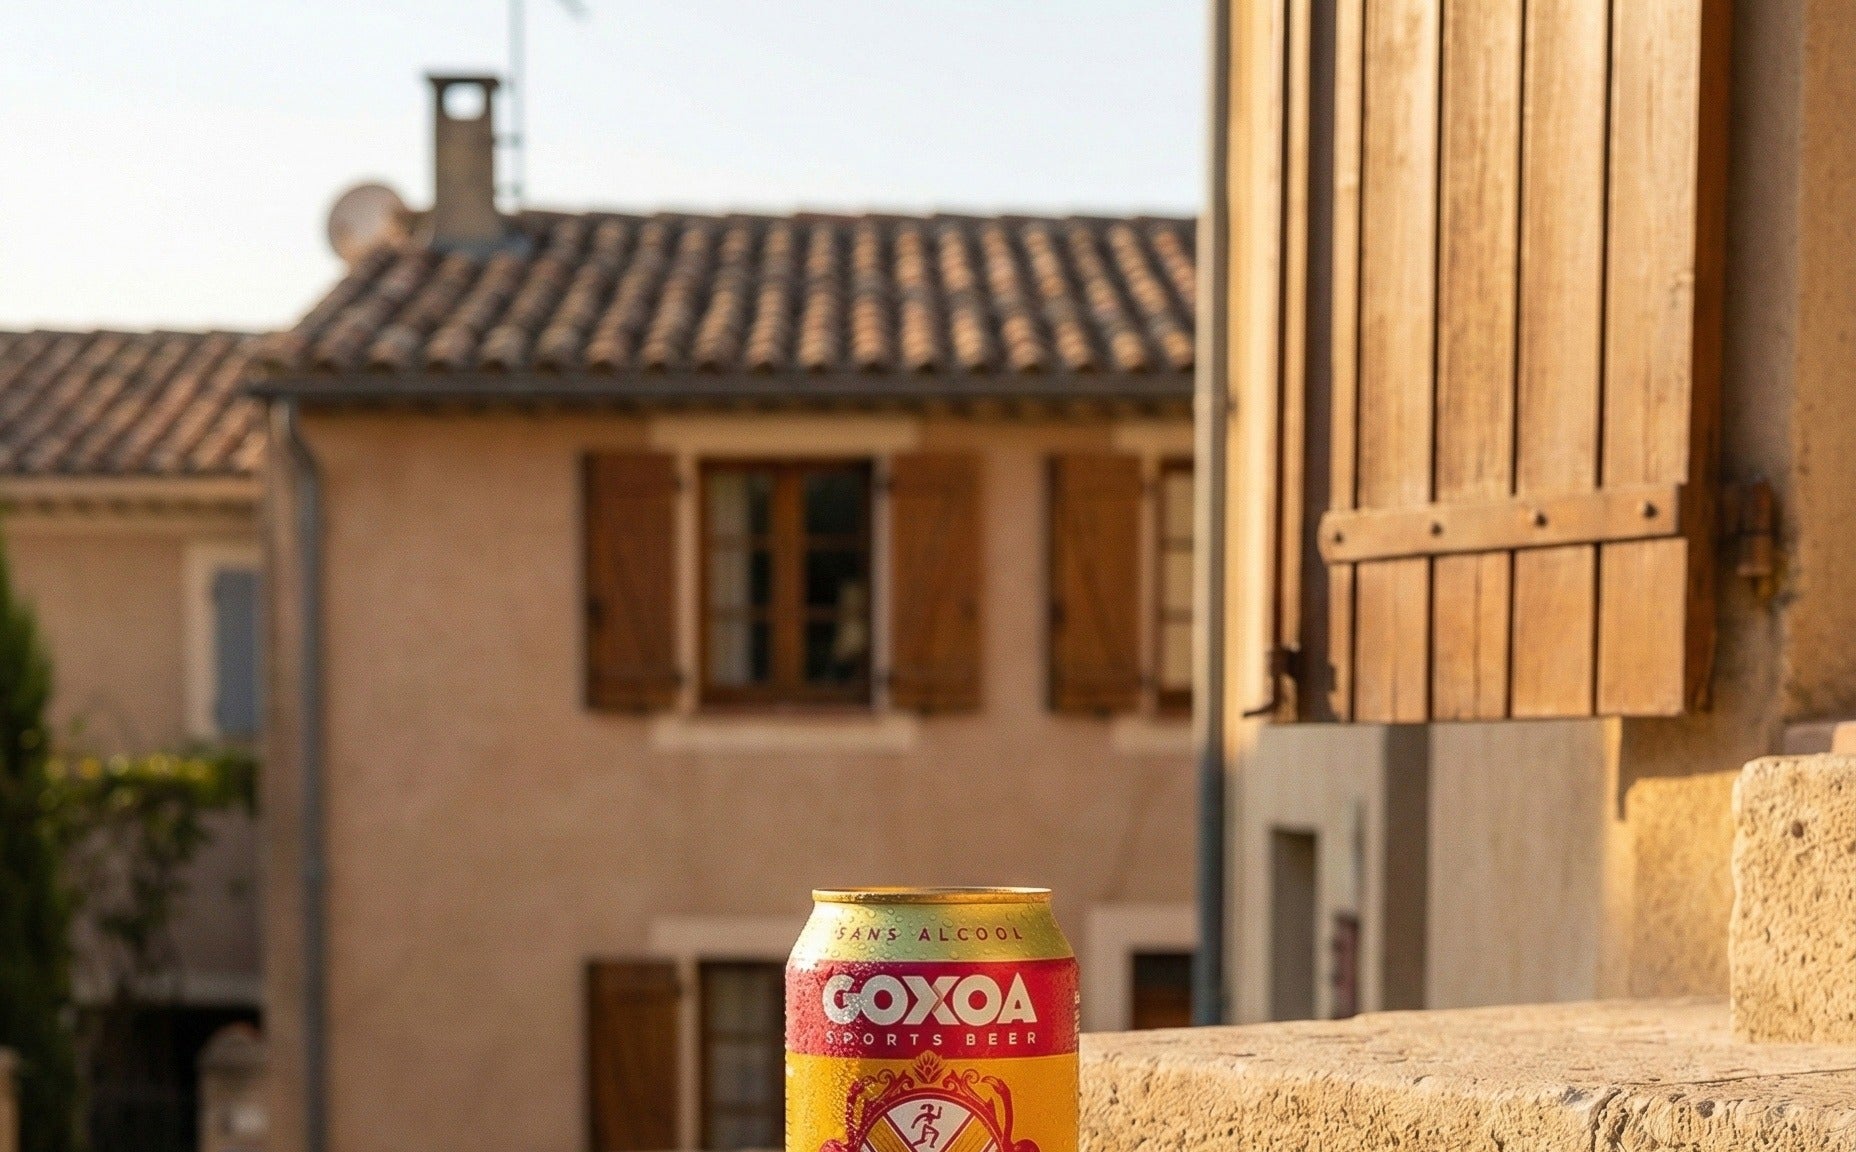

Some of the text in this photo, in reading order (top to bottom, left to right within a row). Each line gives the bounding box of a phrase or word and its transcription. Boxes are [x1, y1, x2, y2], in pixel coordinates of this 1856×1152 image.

[837, 926, 1023, 942] SANS ALCOOL
[822, 971, 1038, 1026] GOXOA
[825, 1030, 1036, 1046] SPORTS BEER
